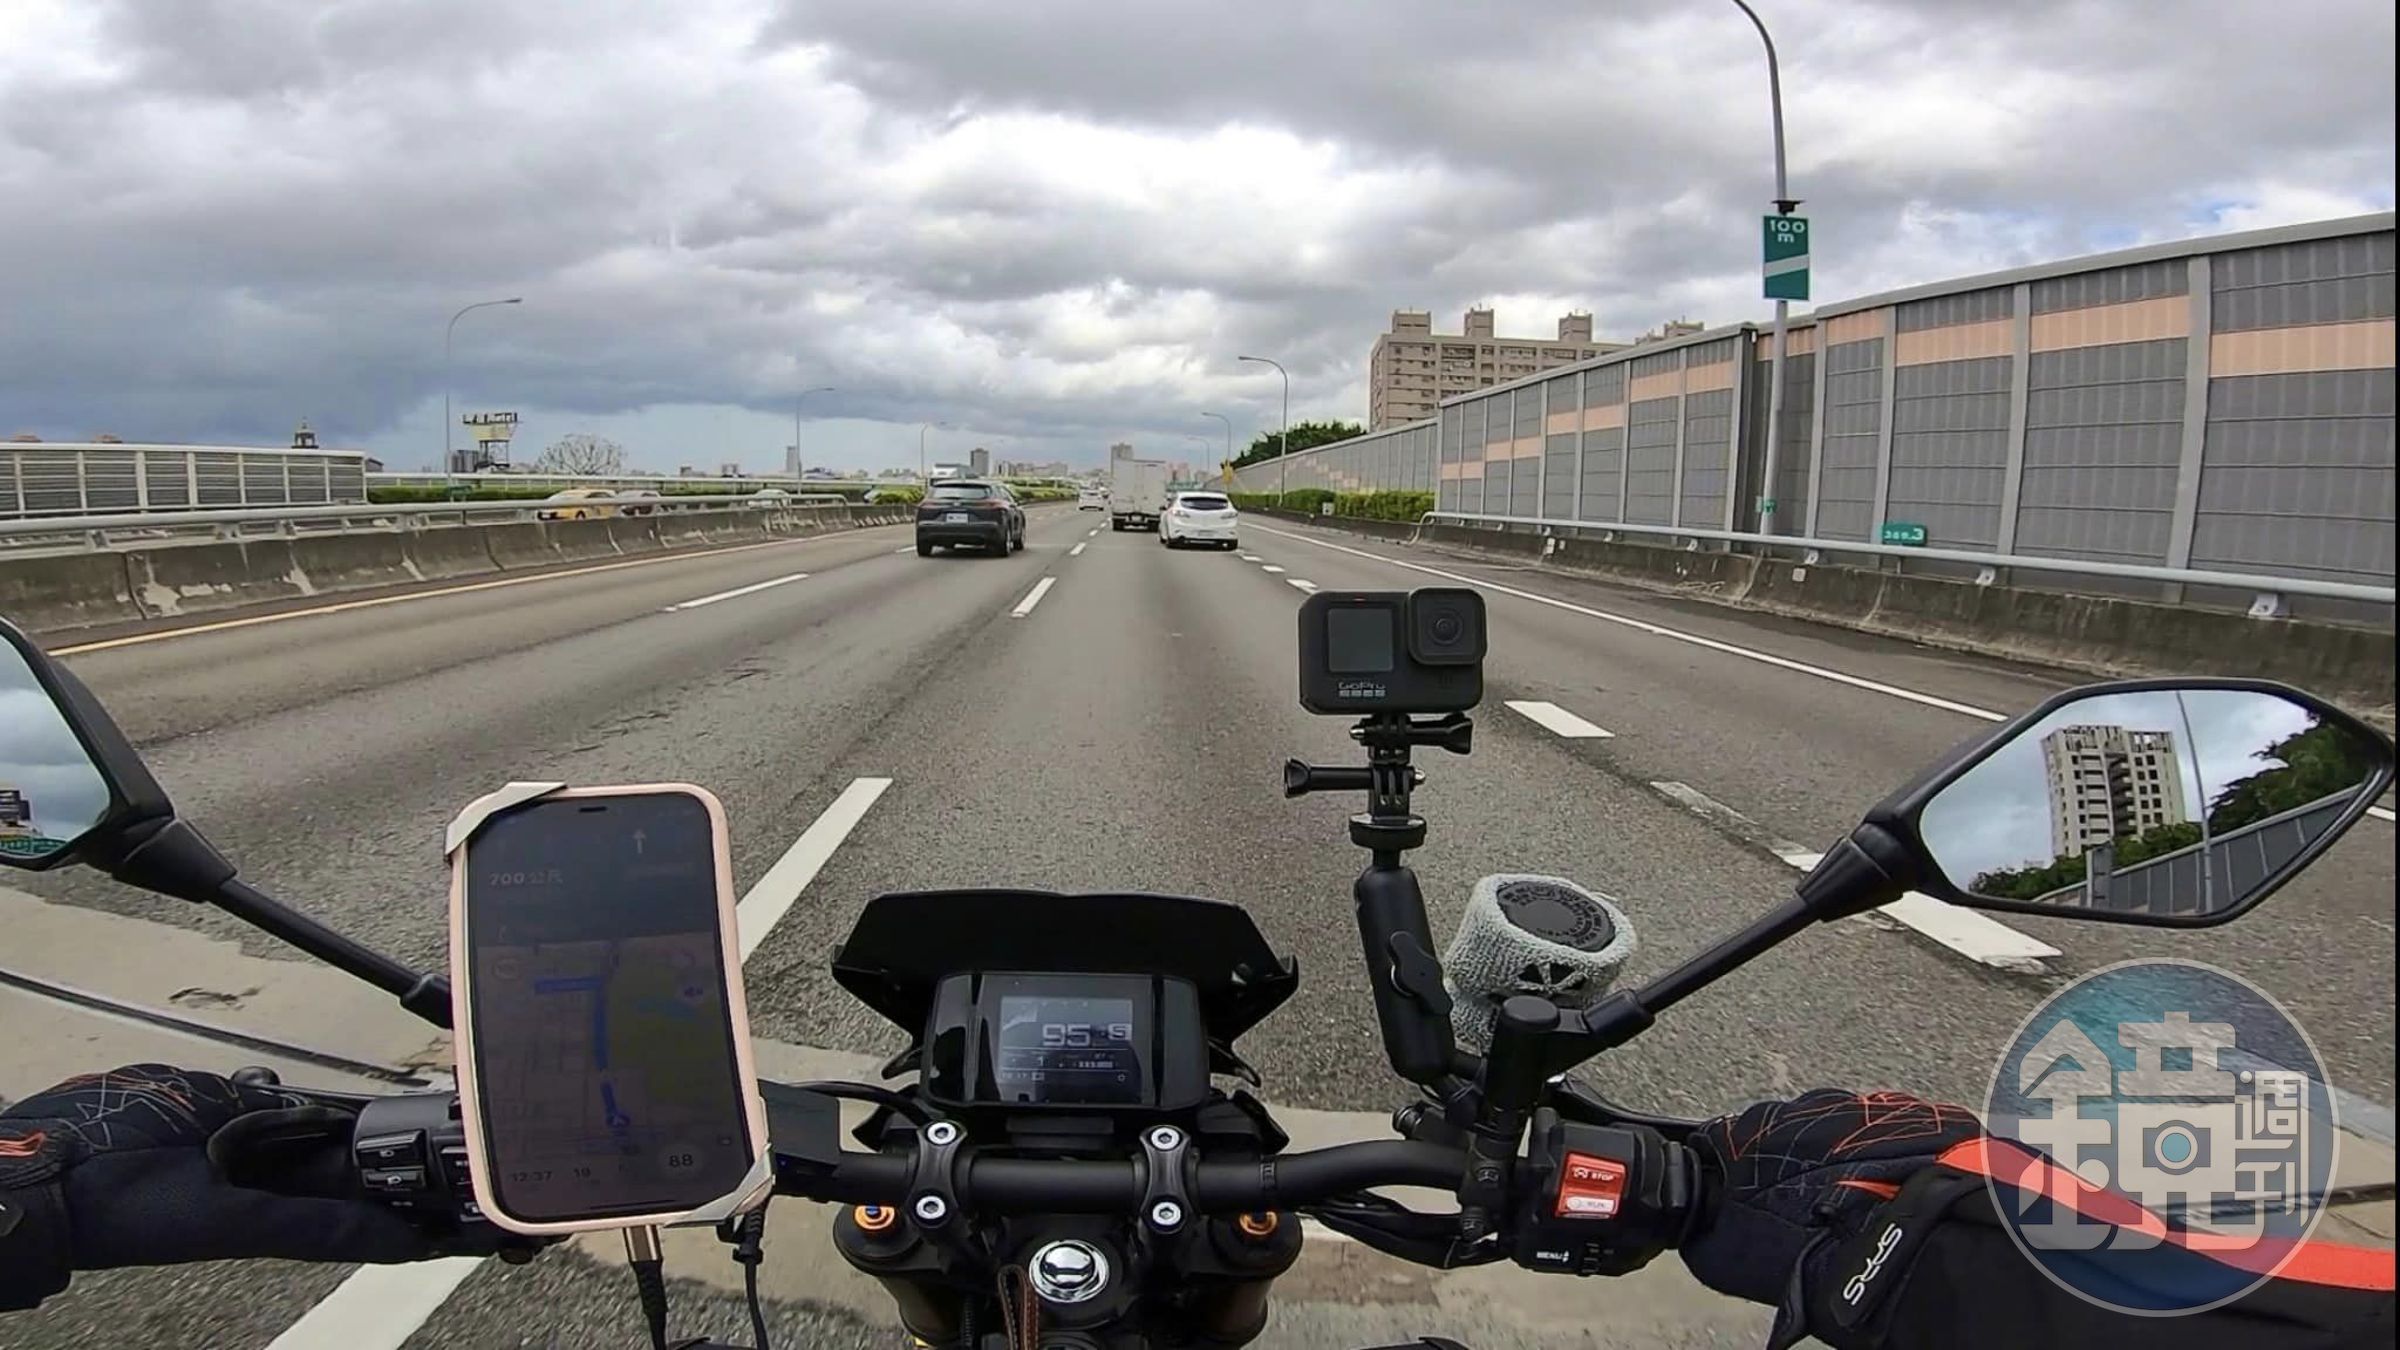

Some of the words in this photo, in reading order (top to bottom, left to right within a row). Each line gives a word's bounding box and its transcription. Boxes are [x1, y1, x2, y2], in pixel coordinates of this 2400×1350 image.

[1770, 219, 1806, 234] 100
[1777, 233, 1795, 243] m
[1042, 1023, 1091, 1047] 95
[669, 1154, 693, 1168] 88
[1590, 1170, 1615, 1181] STOP
